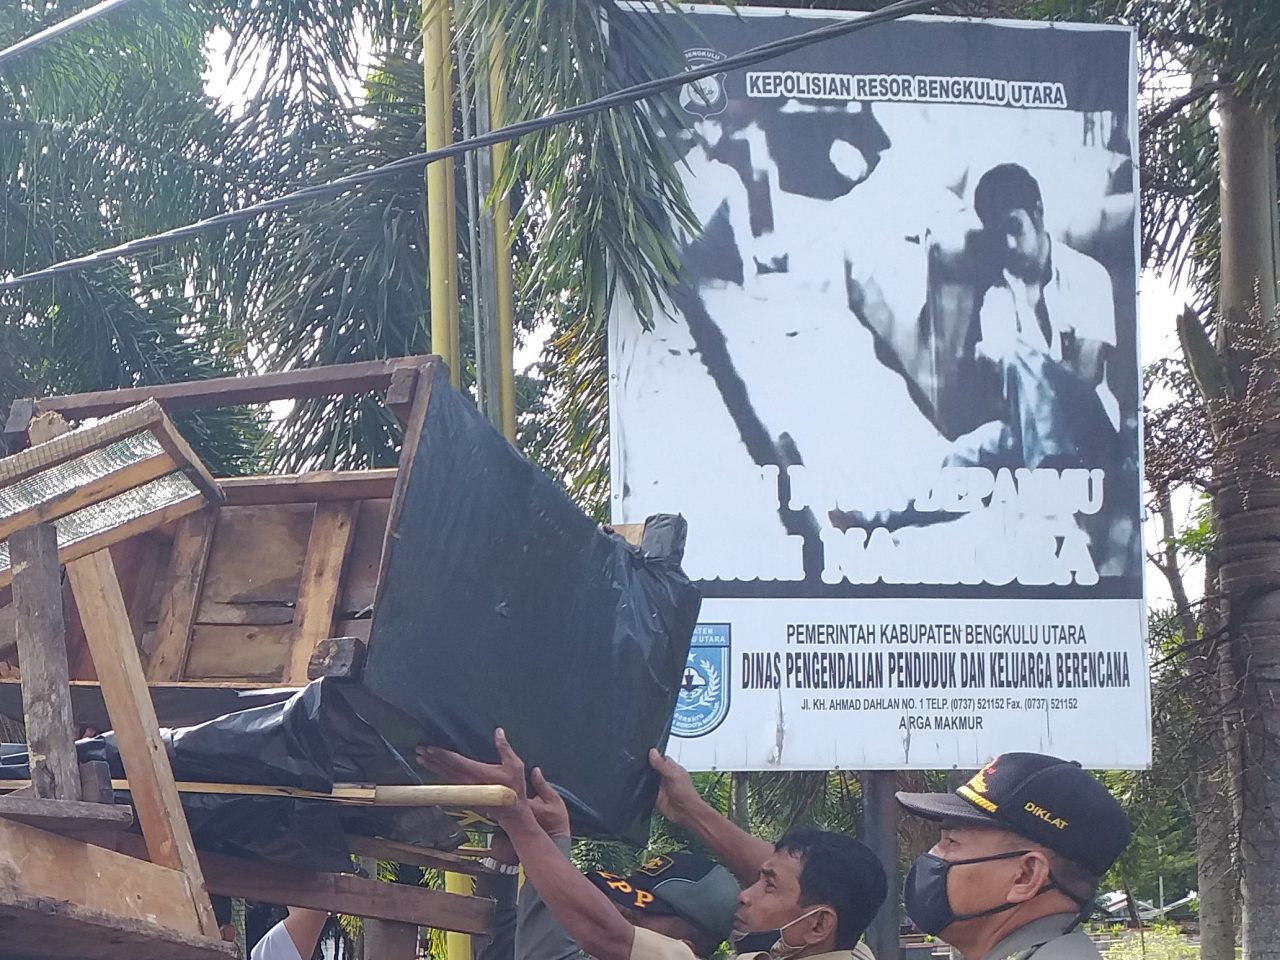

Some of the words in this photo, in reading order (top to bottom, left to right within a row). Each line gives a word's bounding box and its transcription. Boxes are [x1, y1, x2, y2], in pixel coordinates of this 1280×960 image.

[748, 74, 852, 97] KEPOLISIAN
[857, 78, 911, 99] RESOR
[917, 79, 1006, 103] BENGKULU
[1011, 83, 1065, 105] UTARA
[787, 624, 876, 645] PEMERINTAH
[880, 624, 962, 645] KABUPATEN
[965, 624, 1038, 645] BENGKULU
[1042, 624, 1087, 645] UTARA
[742, 651, 781, 690] DINAS
[786, 651, 884, 690] PENGENDALIAN
[888, 651, 957, 689] PENDUDUK
[961, 652, 986, 689] DAN
[989, 651, 1053, 689] KELUARGA
[1056, 651, 1131, 689] BERENCANA
[829, 698, 862, 710] AHMAD
[863, 698, 900, 710] DAHLAN
[901, 698, 917, 710] NO.
[919, 698, 924, 710] 1
[950, 698, 976, 712] (0737)
[977, 698, 1005, 710] 521152
[1006, 698, 1023, 710] Fax.
[1024, 698, 1049, 712] (0737)
[1050, 698, 1078, 710] 521152
[934, 715, 984, 730] MAKMUR
[1023, 801, 1069, 831] DIKLAT
